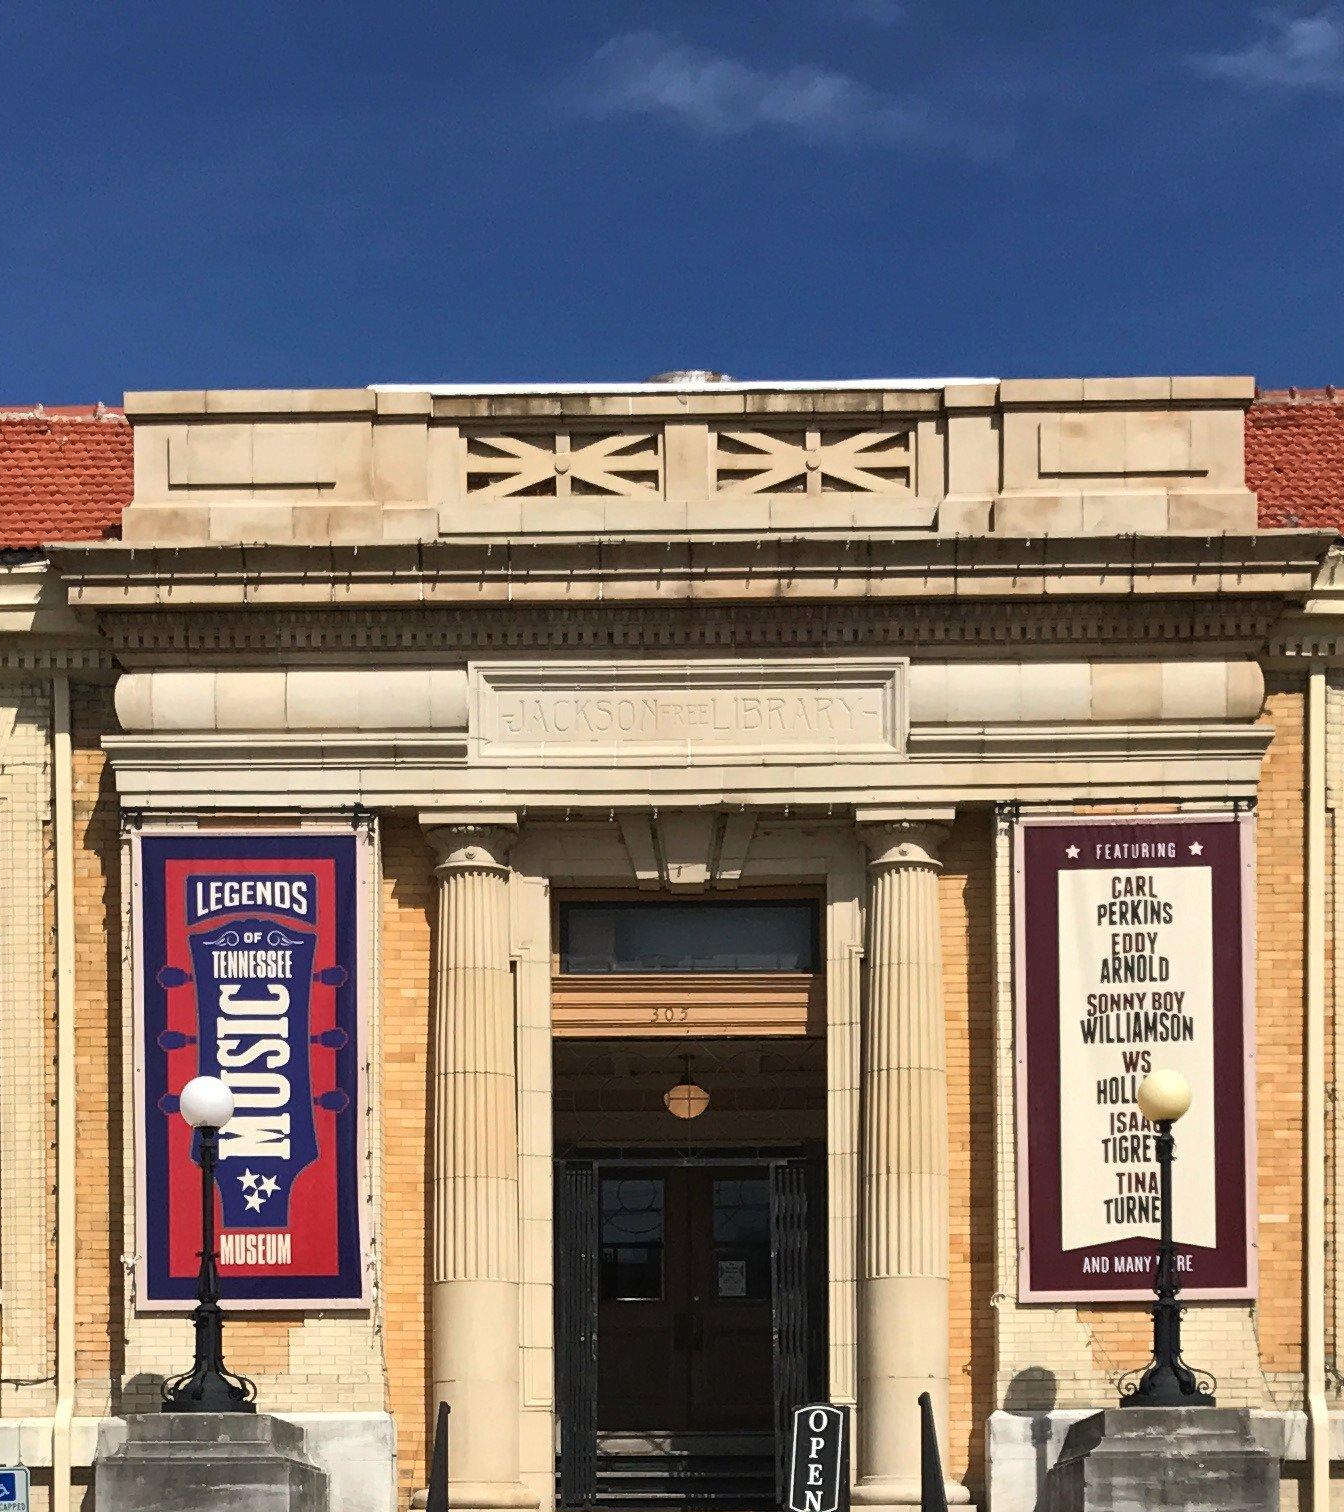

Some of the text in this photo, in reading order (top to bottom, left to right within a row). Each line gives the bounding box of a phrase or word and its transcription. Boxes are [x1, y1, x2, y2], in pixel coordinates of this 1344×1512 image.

[506, 696, 863, 734] JACKSON FREE LIBRARY
[1096, 842, 1176, 860] FEATURING
[196, 880, 307, 916] LEGENDS
[1111, 876, 1158, 899] CARL
[1097, 900, 1173, 927] PERKINS
[244, 932, 262, 944] OF
[1111, 932, 1158, 957] EDDY
[212, 950, 293, 979] TENNESSEE
[1100, 955, 1170, 984] ARNOLD
[1086, 990, 1185, 1016] SONNY BOY
[1080, 1014, 1194, 1045] WILLIAMSON
[215, 984, 291, 1161] MUSIC
[1122, 1051, 1152, 1073] WS
[1115, 1172, 1159, 1195] TINA
[1103, 1195, 1161, 1224] TURNE
[220, 1233, 292, 1265] MUSEUM
[1082, 1257, 1110, 1274] AND
[1114, 1255, 1152, 1273] MANY
[803, 1409, 828, 1512] OPEN
